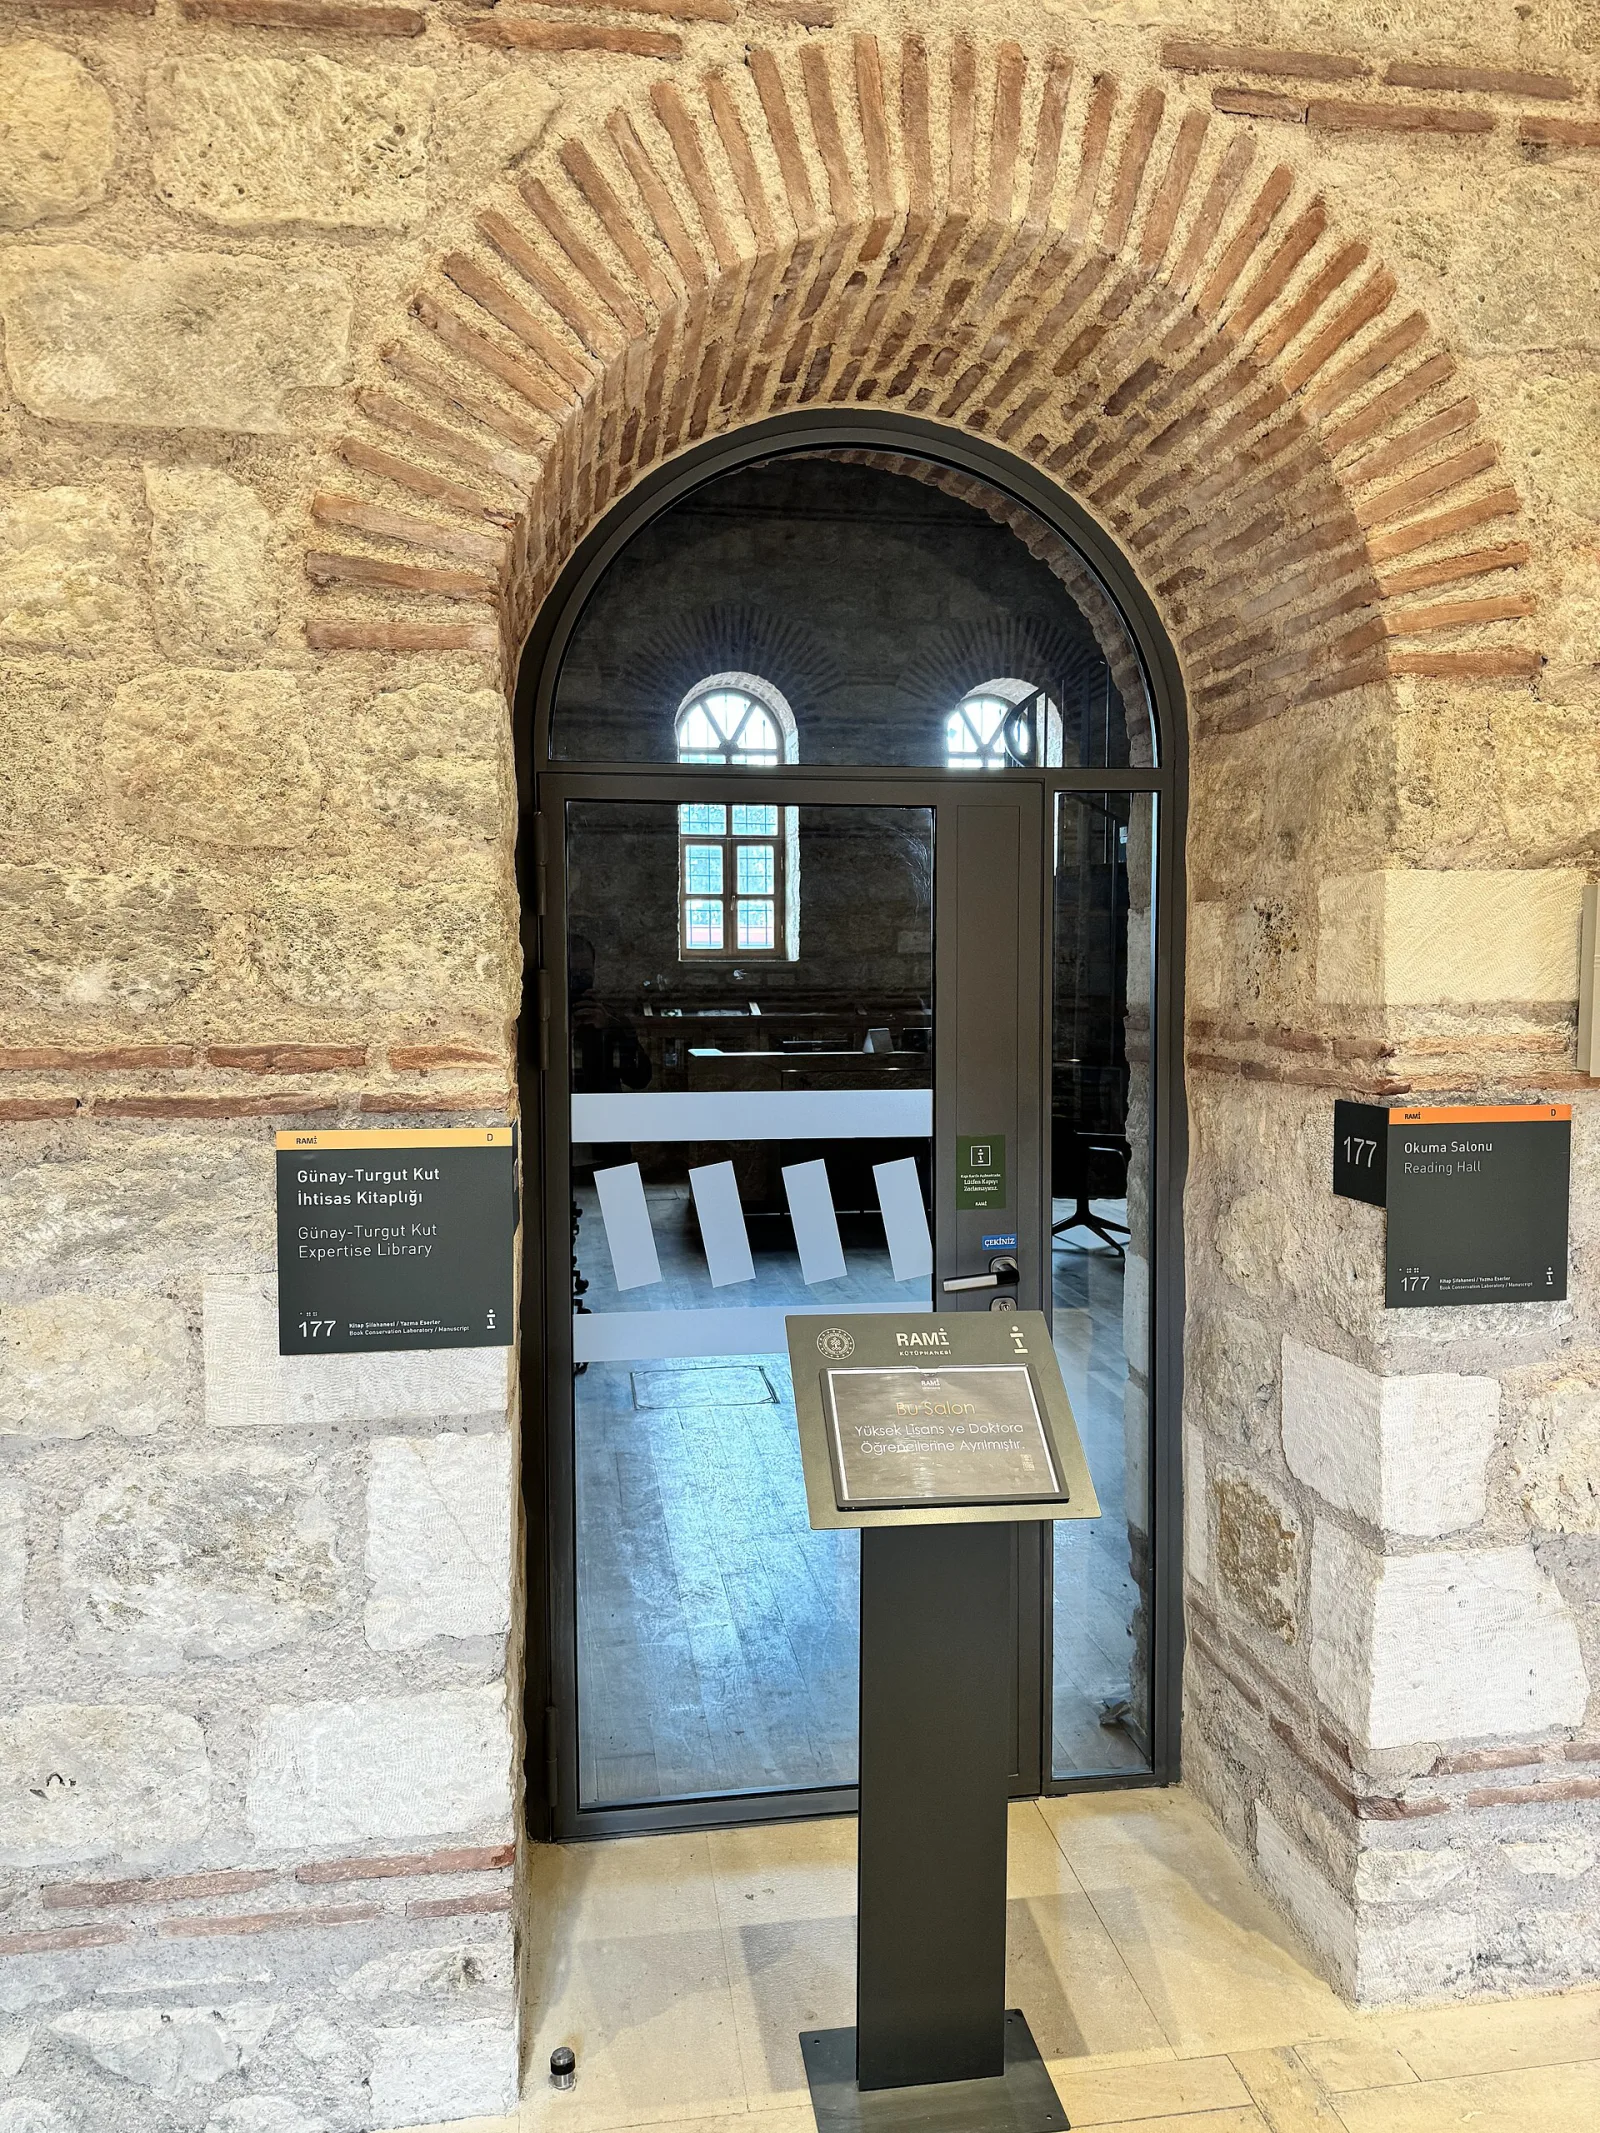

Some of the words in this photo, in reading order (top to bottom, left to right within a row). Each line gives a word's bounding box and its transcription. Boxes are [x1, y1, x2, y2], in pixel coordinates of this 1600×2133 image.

[1551, 1109, 1557, 1117] D
[486, 1133, 494, 1142] D
[1343, 1136, 1377, 1168] 177
[1404, 1142, 1447, 1154] Okuma
[1451, 1141, 1493, 1152] Salonu
[1404, 1162, 1452, 1175] Reading
[1457, 1161, 1481, 1172] Hall
[297, 1168, 408, 1186] Günay-Turgut
[413, 1167, 440, 1181] Kut
[297, 1190, 352, 1206] İhtisas
[357, 1190, 423, 1207] Kitaplığı
[298, 1224, 406, 1242] Günay-Turgut
[411, 1223, 438, 1237] Kut
[984, 1237, 1015, 1247] ÇEKİNİZ
[299, 1244, 372, 1261] Expertise
[377, 1243, 432, 1258] Library
[1400, 1276, 1430, 1292] 177
[298, 1320, 336, 1338] 177
[896, 1402, 918, 1416] Bu
[923, 1401, 976, 1415] Salon
[854, 1424, 902, 1437] Yüksek
[905, 1423, 945, 1436] Lisans
[949, 1426, 966, 1434] ve
[969, 1423, 1024, 1434] Doktora
[861, 1440, 955, 1456] Öğrencilerine
[959, 1439, 1025, 1452] Ayrılmıştır.
